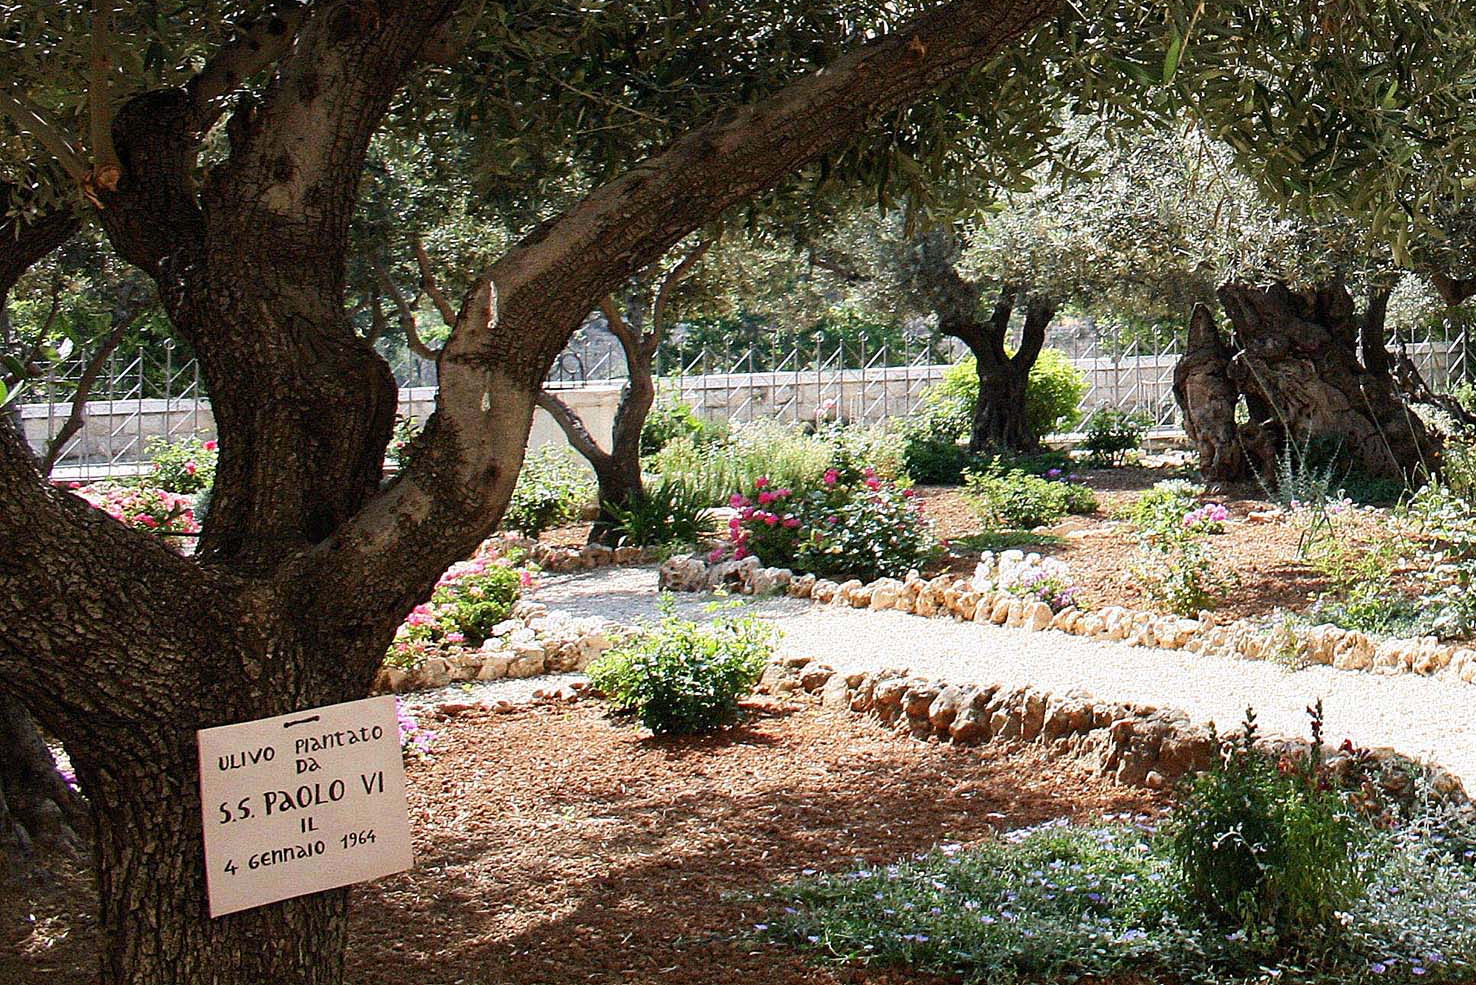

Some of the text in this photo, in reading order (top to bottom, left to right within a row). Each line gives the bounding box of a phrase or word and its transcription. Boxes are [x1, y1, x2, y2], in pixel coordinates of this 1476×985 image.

[218, 746, 276, 772] ULIVO
[219, 796, 256, 825] S.S.
[360, 770, 384, 795] VI
[300, 816, 320, 834] IL
[223, 859, 240, 876] 4
[340, 829, 377, 850] 1964
